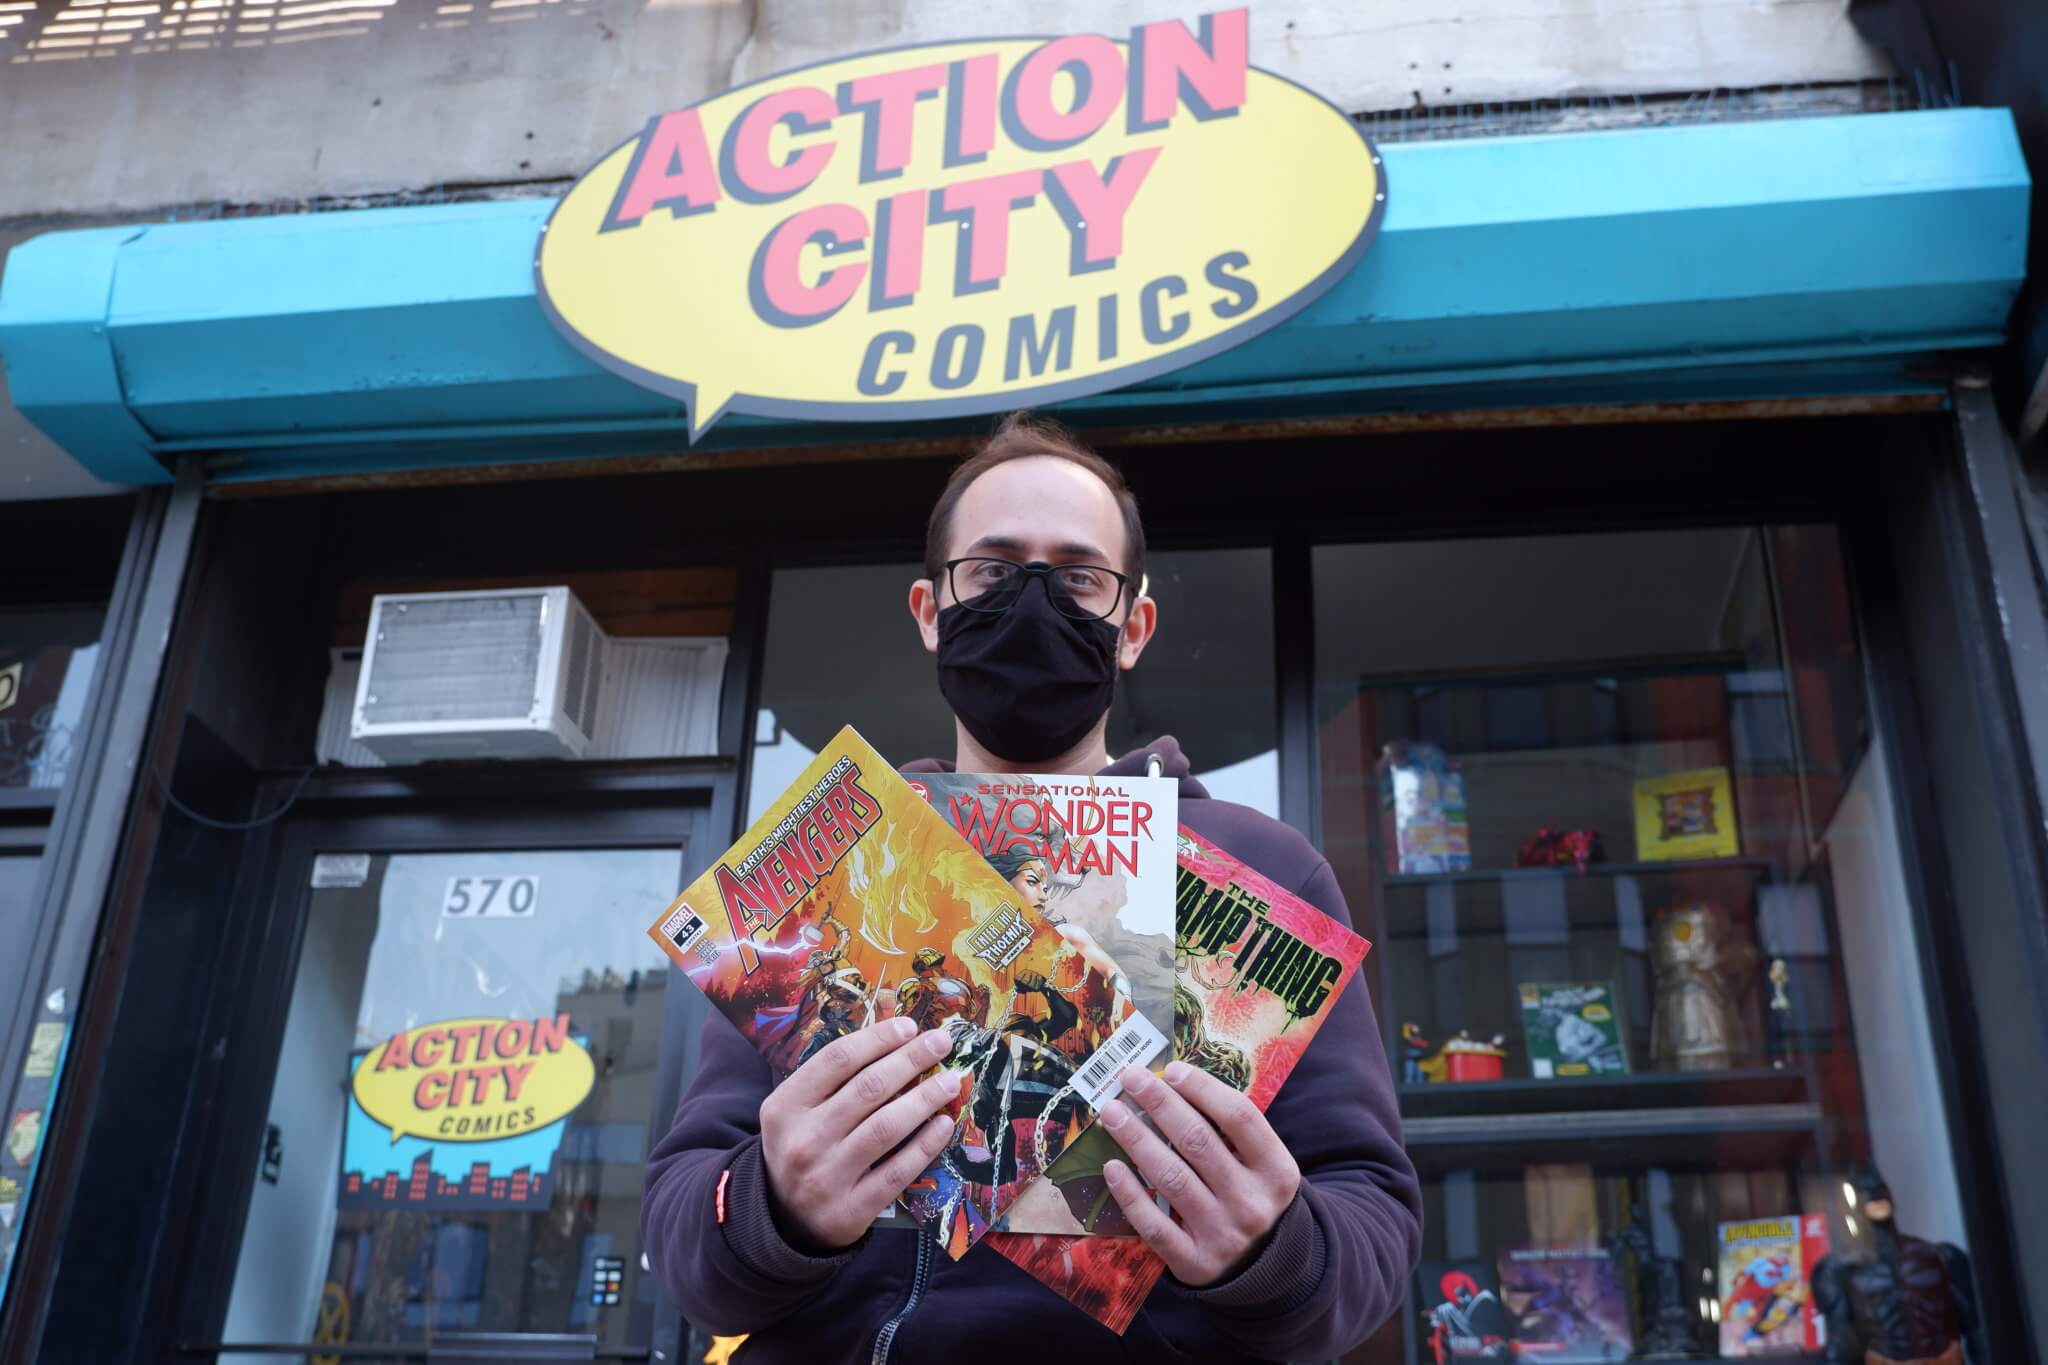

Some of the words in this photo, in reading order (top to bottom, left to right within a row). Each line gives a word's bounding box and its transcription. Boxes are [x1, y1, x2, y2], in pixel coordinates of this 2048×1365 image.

[598, 8, 1249, 234] ACTION
[748, 146, 1163, 329] CITY
[856, 250, 1259, 397] COMICS
[736, 837, 774, 876] EARTH'S
[772, 791, 817, 840] MIGHTIEST
[815, 756, 851, 795] HEROES
[977, 784, 1130, 797] SENSATIONAL
[949, 796, 1155, 847] WONDER
[714, 763, 882, 976] AVENGERS
[447, 878, 535, 914] 570
[662, 906, 693, 937] MARVEL
[1229, 881, 1271, 916] THE
[681, 924, 695, 939] 43
[745, 916, 761, 931] THE
[975, 923, 1001, 949] ENTER
[995, 910, 1013, 928] THE
[976, 911, 1028, 962] PHOENIX
[1176, 864, 1252, 955] AMP
[1232, 916, 1343, 1020] THING
[373, 1013, 571, 1073] ACTION
[414, 1060, 536, 1111] CITY
[439, 1107, 536, 1134] COMICS
